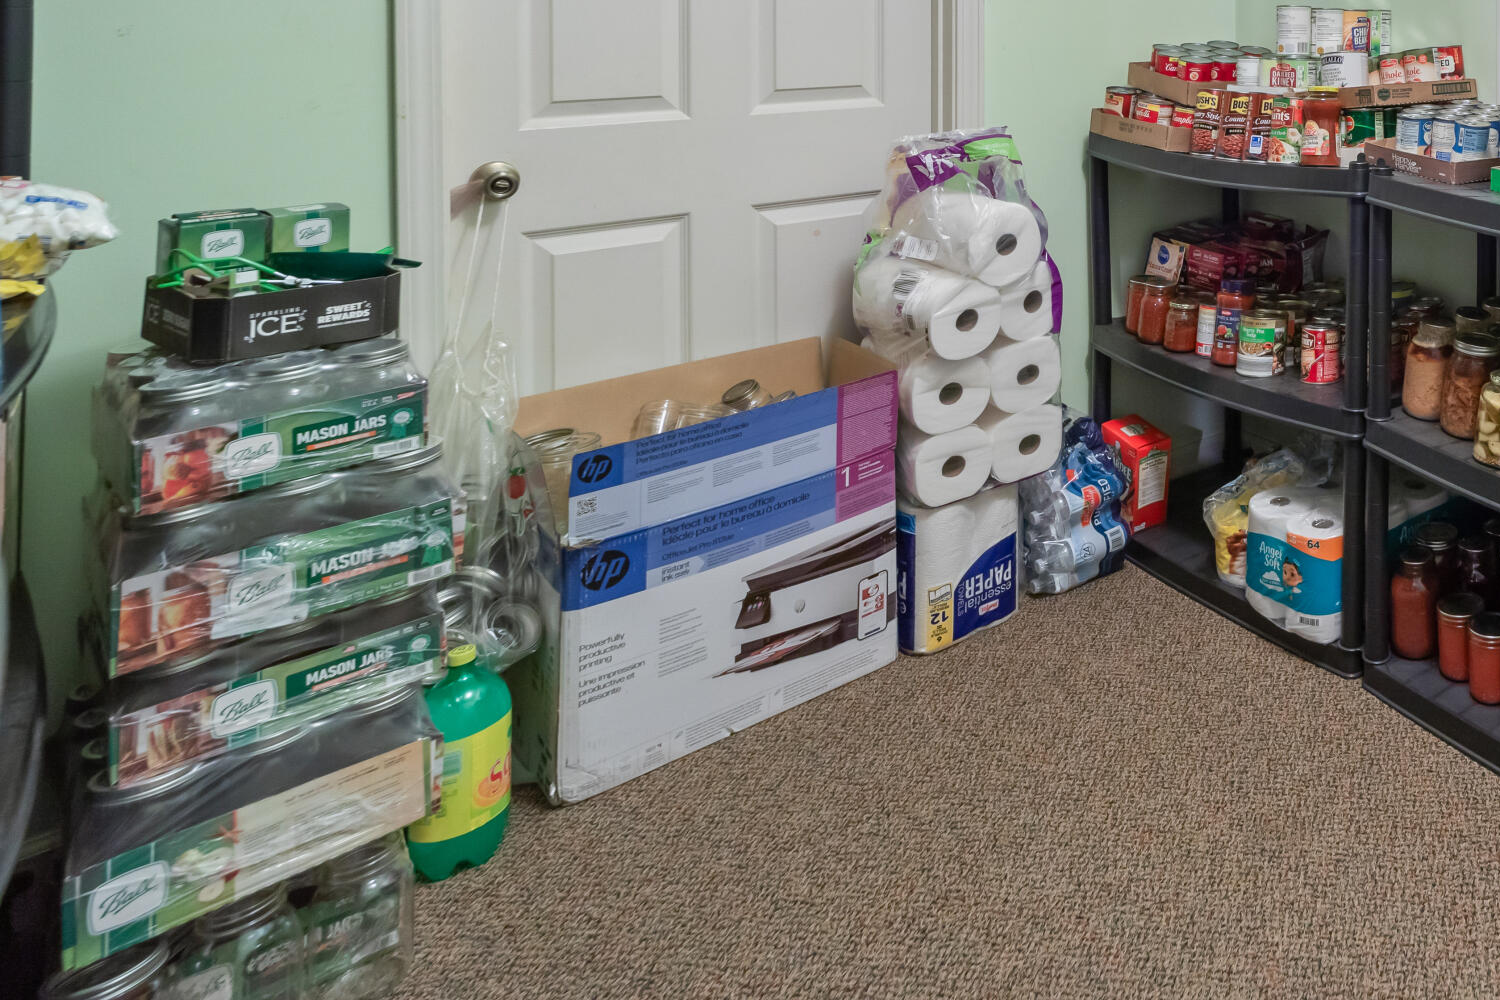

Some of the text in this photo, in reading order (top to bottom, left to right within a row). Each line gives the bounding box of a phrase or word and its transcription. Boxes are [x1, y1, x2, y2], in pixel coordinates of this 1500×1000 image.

[1392, 153, 1416, 166] Happy
[207, 234, 239, 253] Ball
[250, 306, 302, 319] SPARKLING
[317, 309, 371, 325] REWARDS
[325, 301, 363, 315] SWEET
[248, 312, 300, 339] ICE
[296, 414, 387, 446] MASON JARS
[636, 436, 665, 449] Perfect
[678, 428, 700, 440] home
[577, 454, 612, 483] hp
[841, 466, 850, 488] 1
[662, 494, 777, 537] Perfect for home office
[695, 523, 721, 541] pour
[721, 517, 730, 529] le
[731, 507, 765, 526] bureau
[774, 491, 811, 512] domicile
[1259, 541, 1283, 560] Angel
[1307, 540, 1321, 549] 64
[310, 546, 372, 578] MASON
[580, 550, 630, 591] hp
[1264, 555, 1280, 571] Soft
[235, 573, 285, 606] Ball
[965, 559, 1012, 599] PAPER
[957, 582, 966, 617] TOWELS
[965, 581, 1012, 613] essential
[931, 610, 949, 625] 12
[578, 633, 625, 652] Powerfully
[578, 642, 626, 663] productive
[305, 648, 394, 686] MASON JARS
[578, 655, 613, 672] printing
[578, 677, 597, 688] Une
[598, 660, 645, 682] impression
[578, 677, 625, 698] productive
[578, 687, 622, 708] puissante
[220, 689, 269, 725] Ball
[98, 875, 159, 920] Ball
